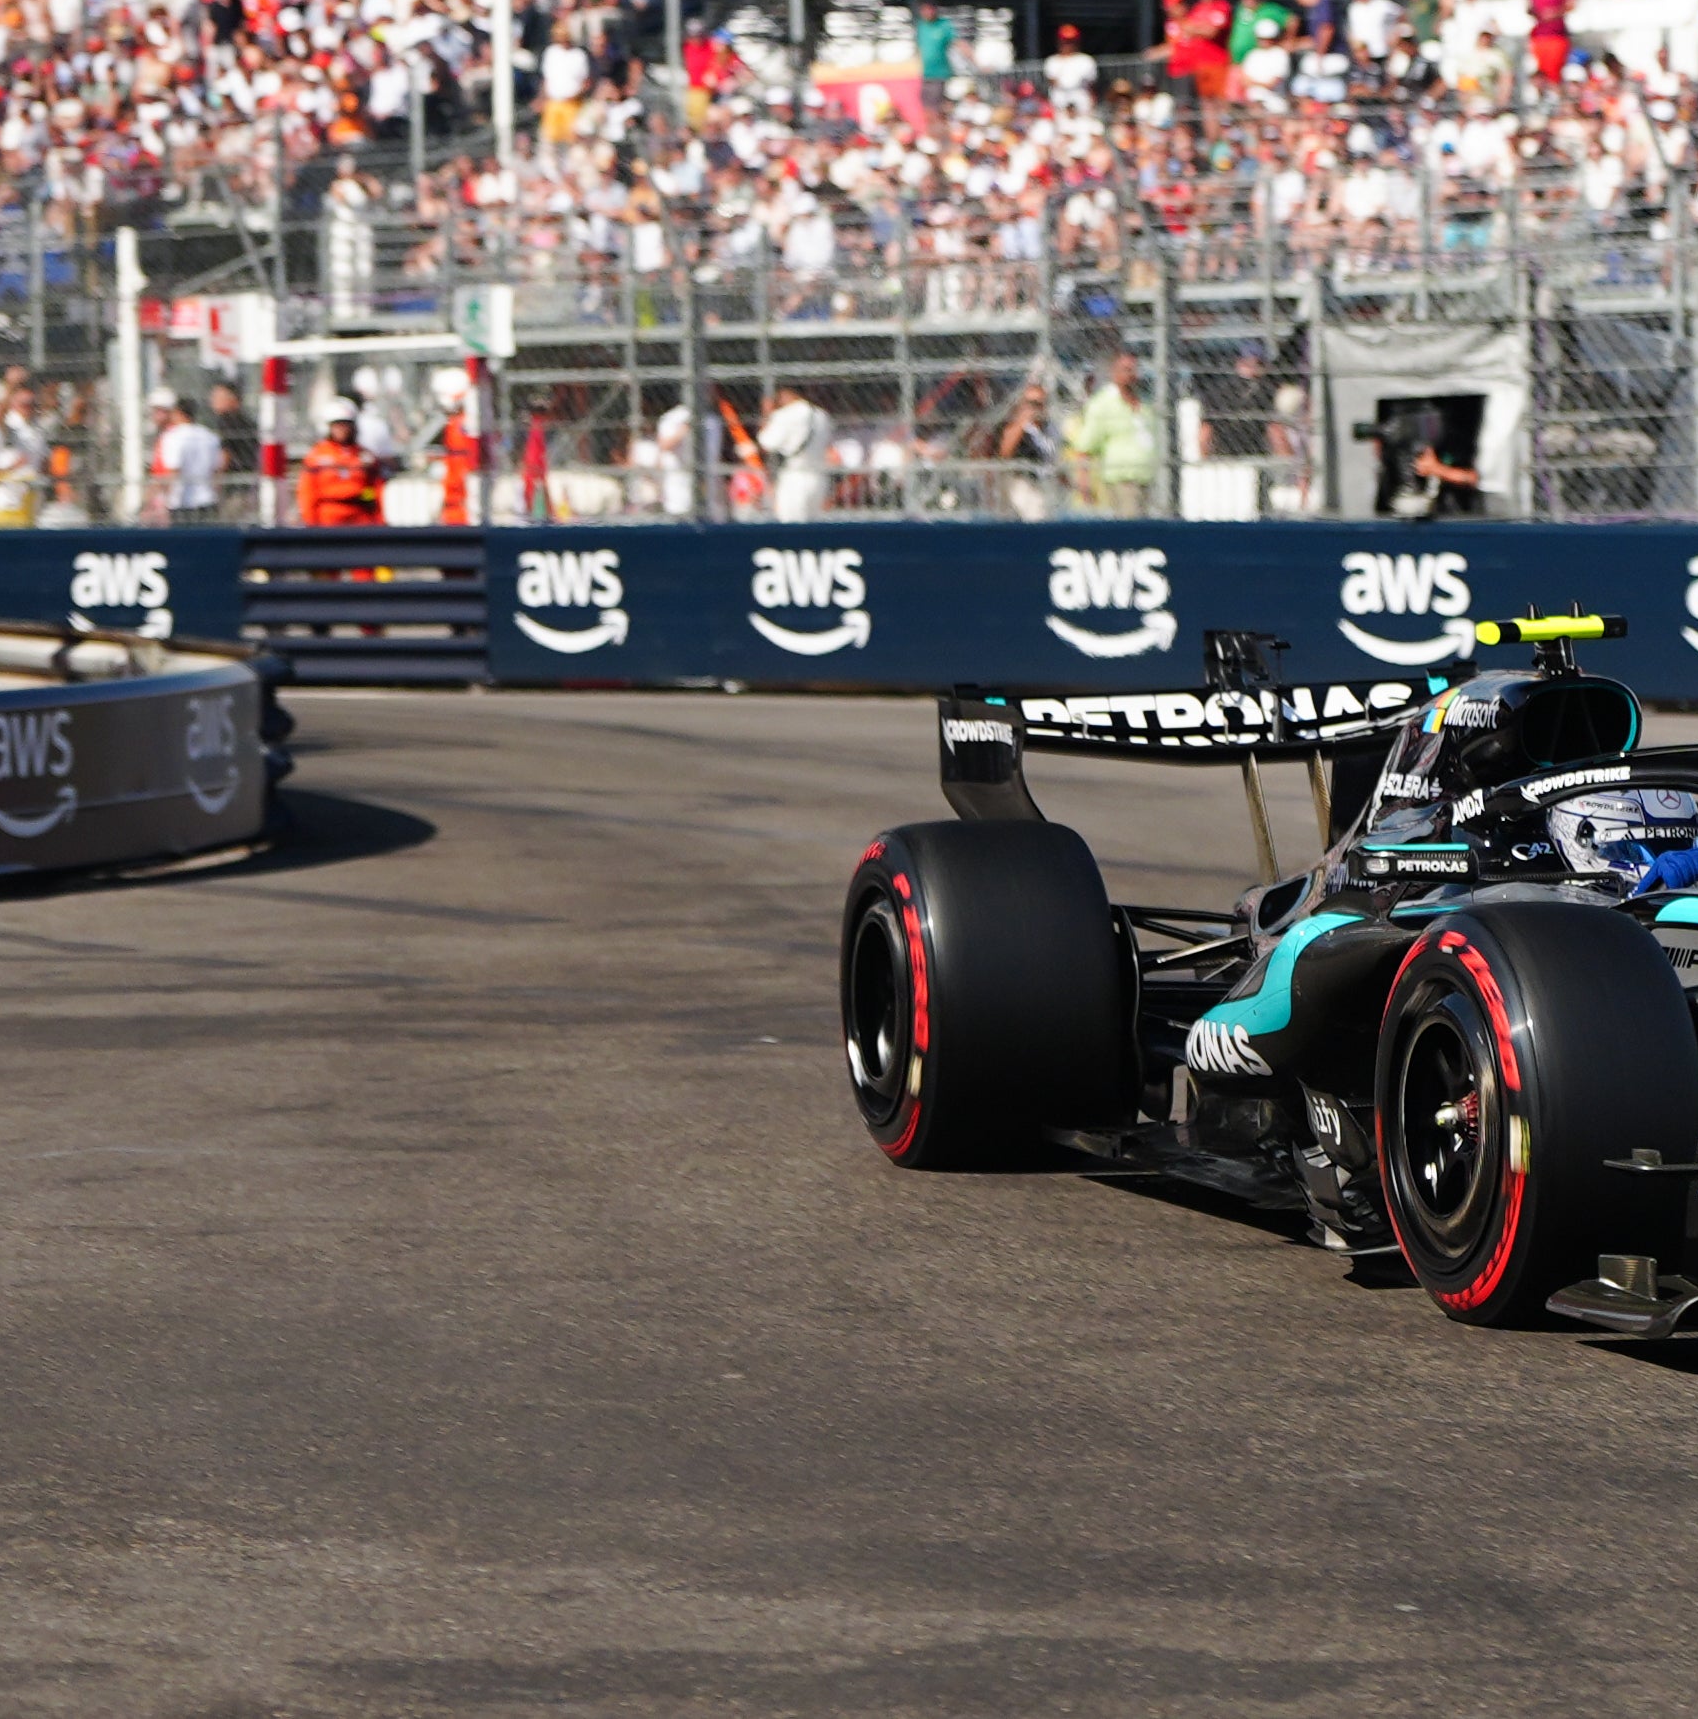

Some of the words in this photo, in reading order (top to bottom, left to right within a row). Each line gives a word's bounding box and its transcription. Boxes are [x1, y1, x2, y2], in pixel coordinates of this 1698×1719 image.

[71, 551, 169, 609] aws
[517, 549, 623, 609] aws
[752, 548, 865, 609] aws
[1049, 547, 1170, 611] aws
[1341, 552, 1470, 617] aws
[186, 692, 236, 760] aws
[947, 718, 1013, 747] CROWDSTRIKE
[1443, 695, 1500, 729] Microsoft
[1383, 772, 1429, 800] SOLERA
[1524, 766, 1631, 800] CROWDSTRIKE
[1452, 794, 1478, 826] AMD
[1397, 858, 1469, 874] PETRONAS
